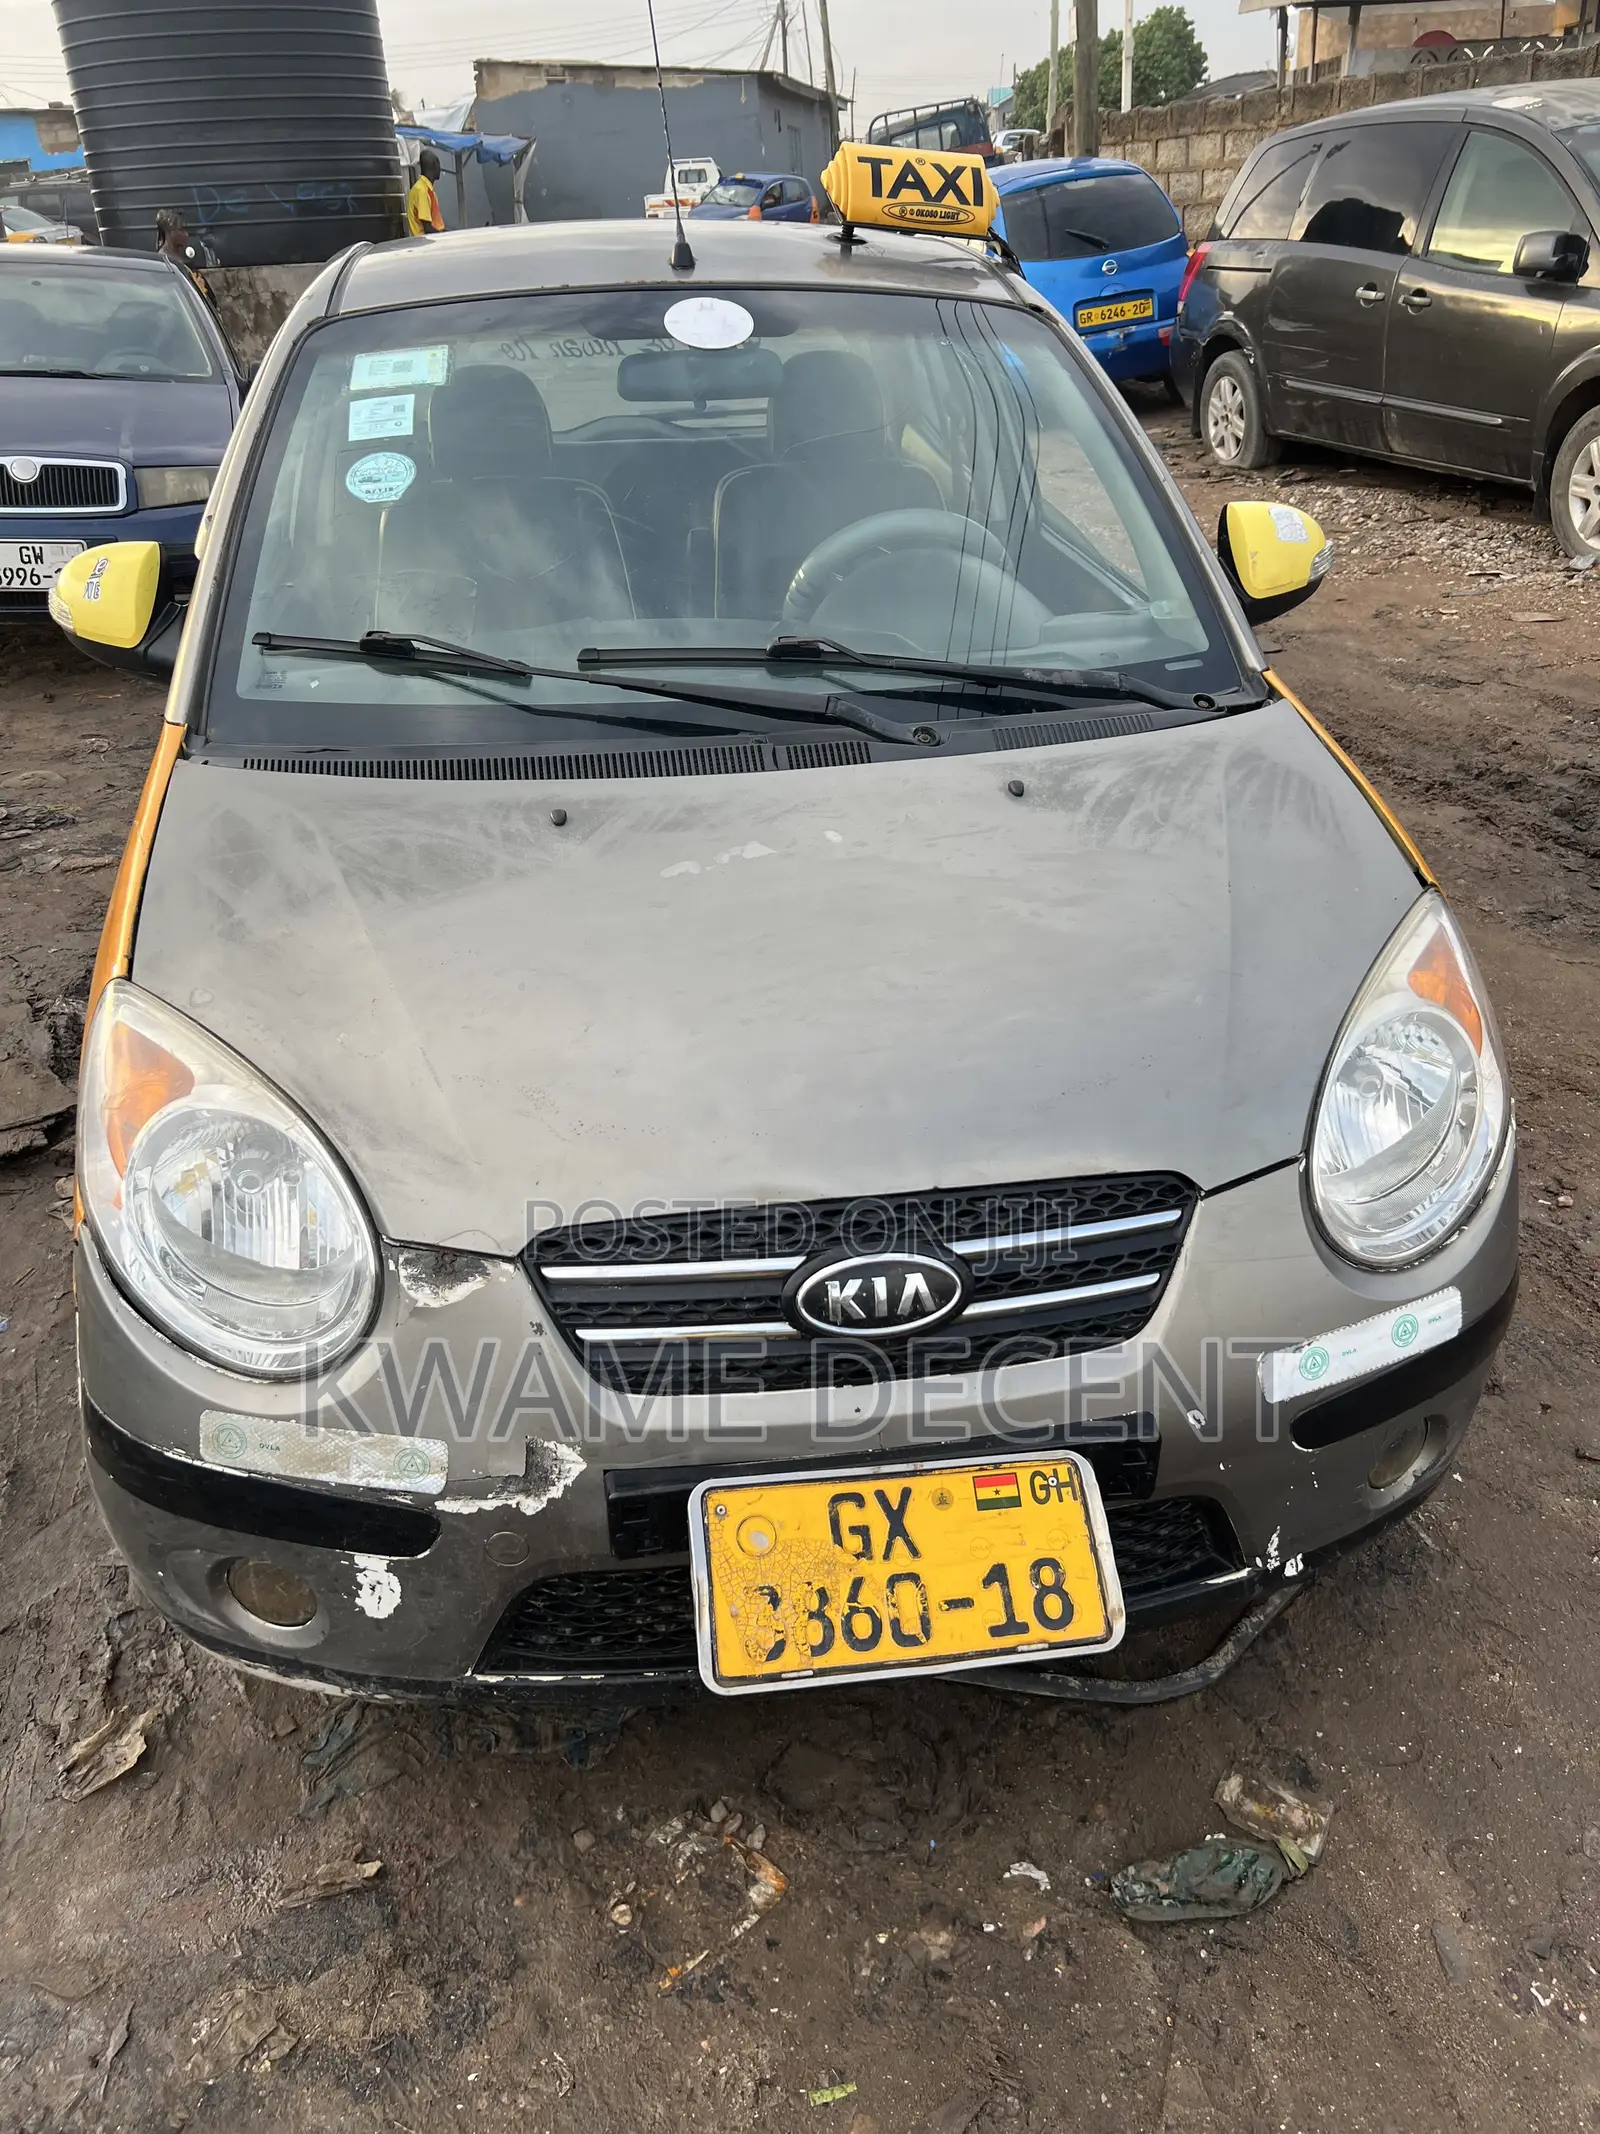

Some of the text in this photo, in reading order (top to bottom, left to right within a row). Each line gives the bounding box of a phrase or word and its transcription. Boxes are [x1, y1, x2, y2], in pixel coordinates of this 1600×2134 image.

[857, 156, 984, 207] TAXI
[939, 210, 960, 221] LIGHT
[1079, 311, 1093, 324] GR
[19, 545, 44, 565] GW
[0, 567, 62, 586] 996-
[824, 1272, 937, 1323] KIA
[1030, 1466, 1078, 1505] GH
[827, 1486, 922, 1563] GX
